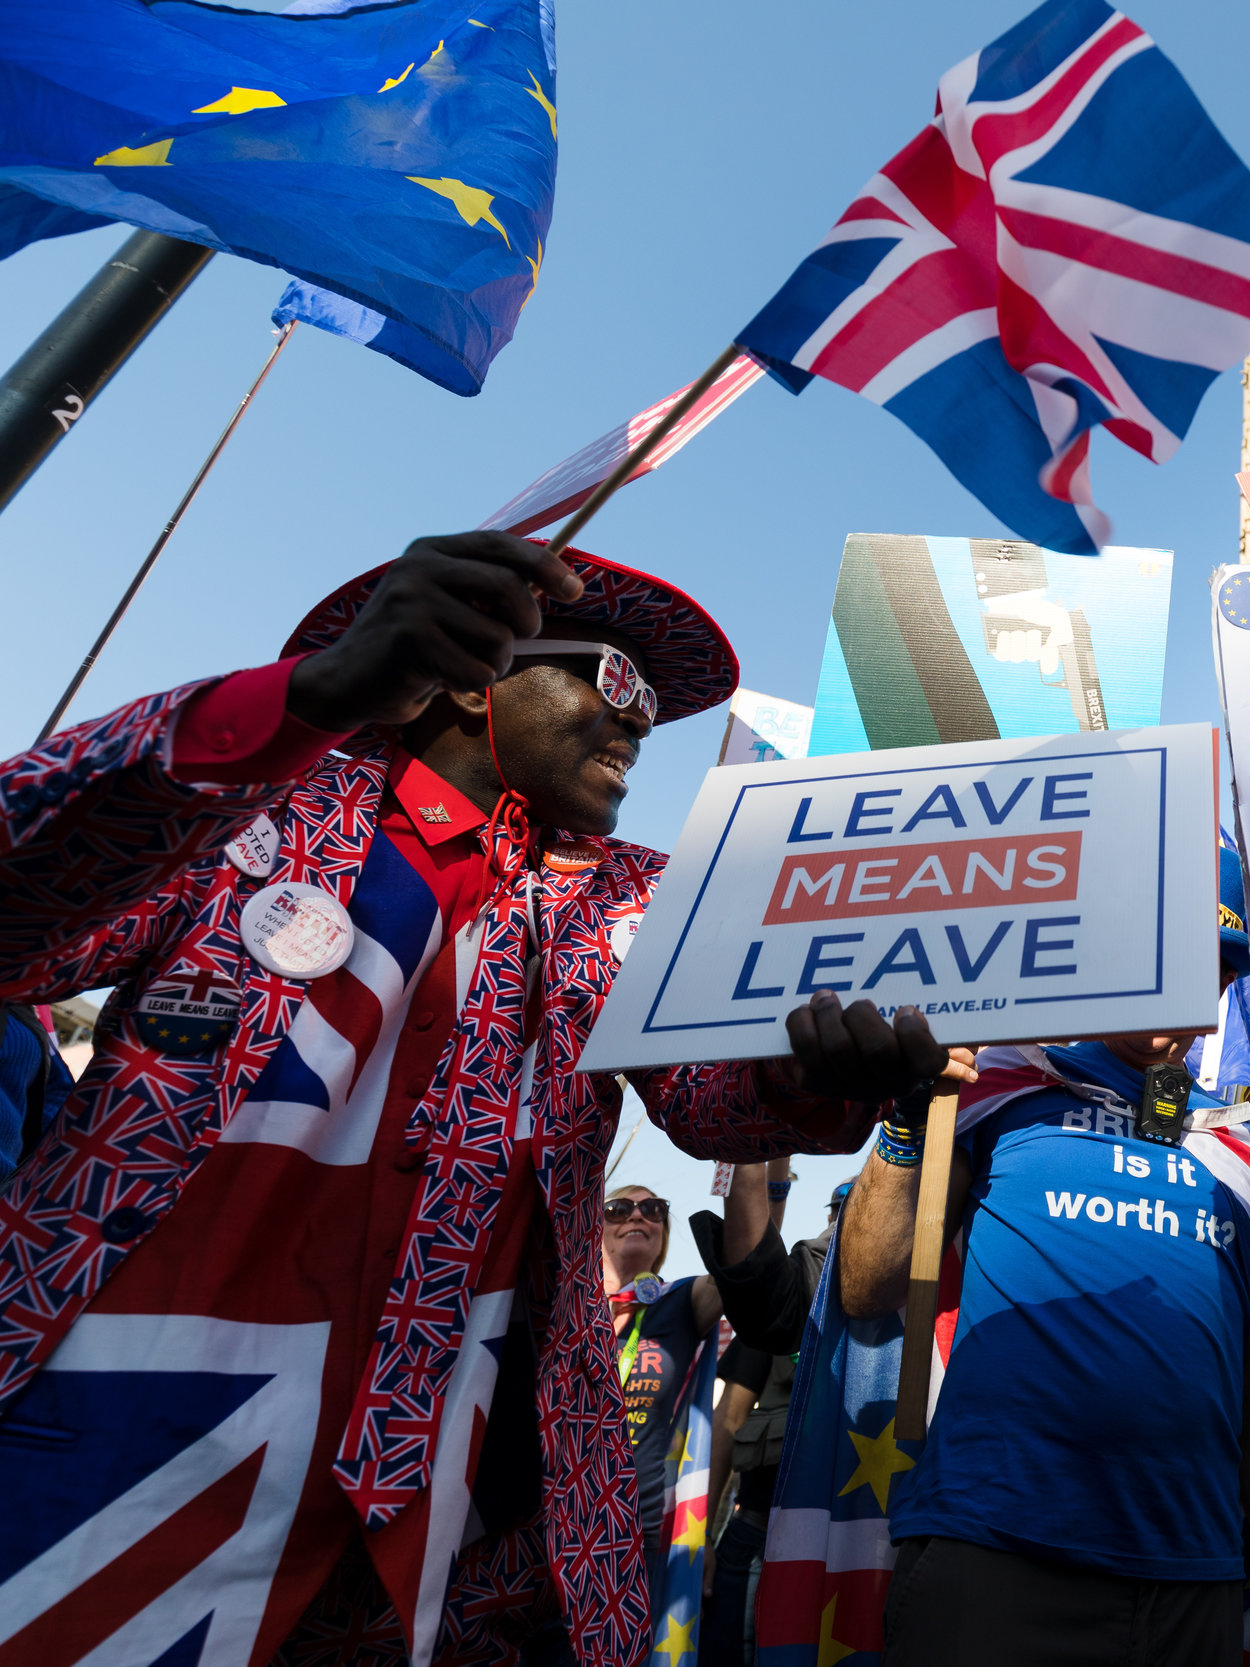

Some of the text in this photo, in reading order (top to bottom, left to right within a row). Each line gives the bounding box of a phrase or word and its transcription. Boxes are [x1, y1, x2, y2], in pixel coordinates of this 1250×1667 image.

[51, 394, 84, 432] 2
[786, 772, 1094, 843] LEAVE
[549, 853, 598, 864] BRITAIN
[553, 847, 590, 858] BELIEVE
[780, 846, 1067, 910] MEANS
[731, 915, 1081, 1000] LEAVE
[147, 1000, 239, 1018] LEAVE MEANS LEAVE
[1113, 1145, 1197, 1187] is it
[1045, 1191, 1237, 1250] worth it?
